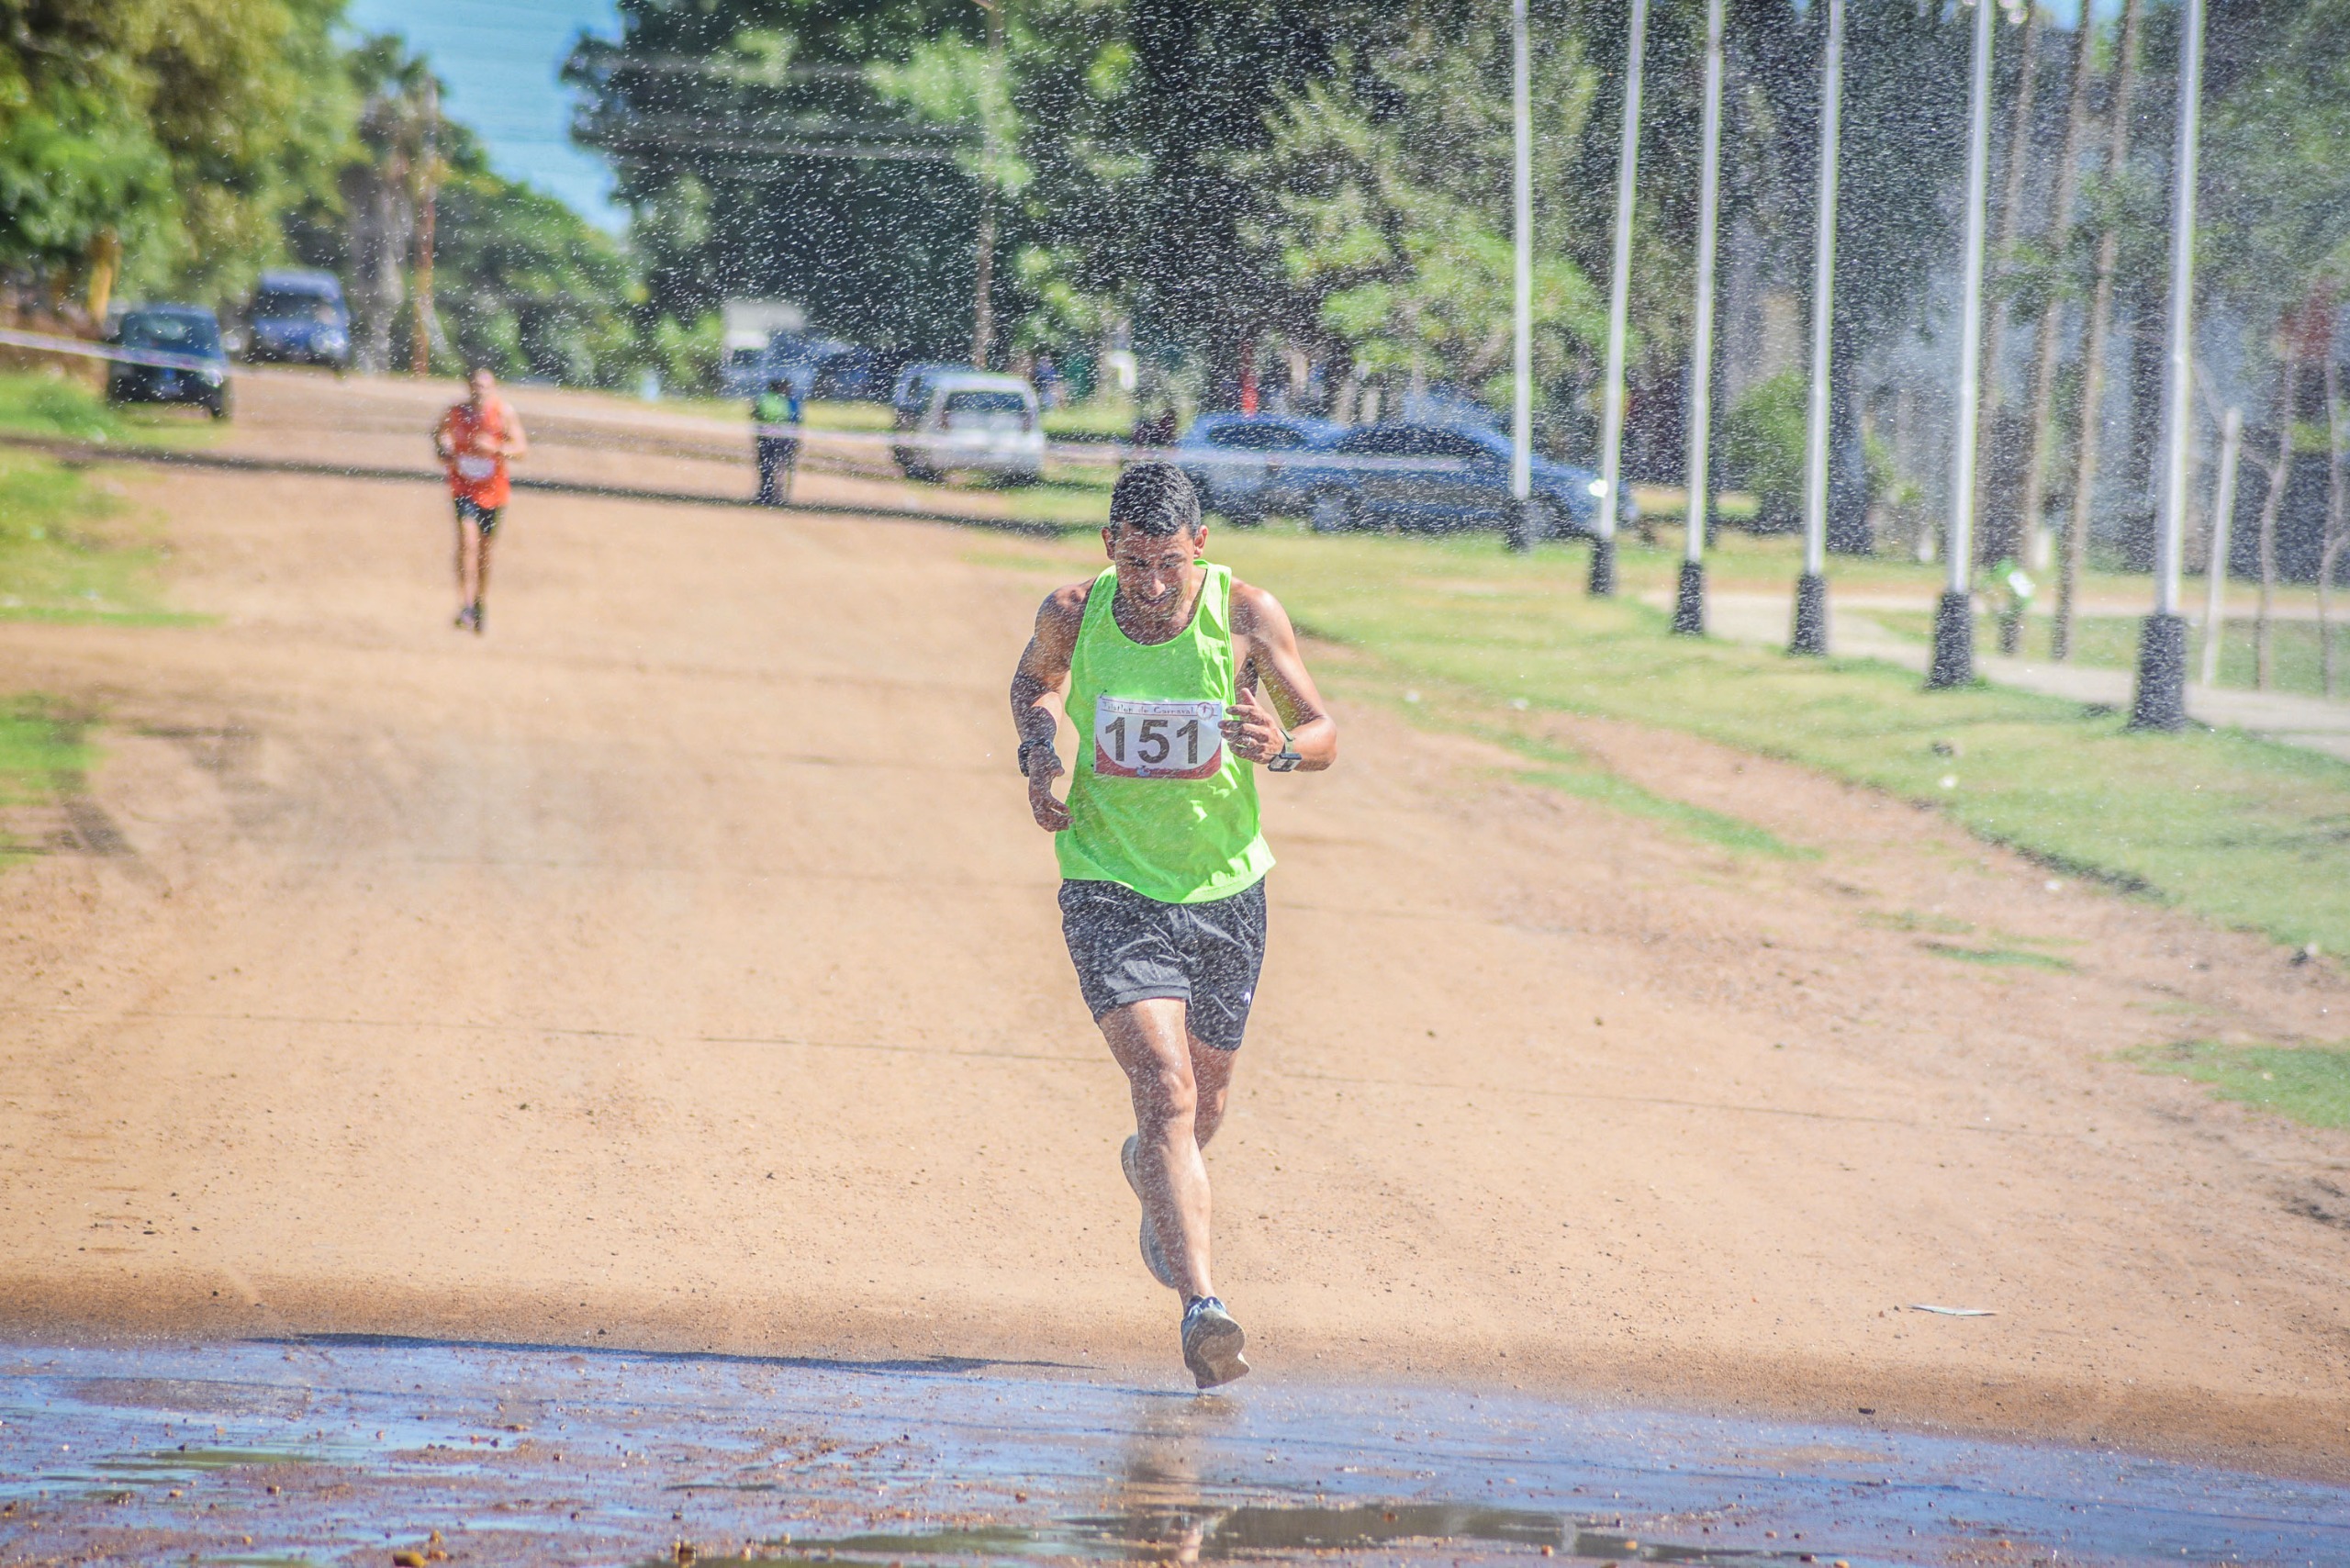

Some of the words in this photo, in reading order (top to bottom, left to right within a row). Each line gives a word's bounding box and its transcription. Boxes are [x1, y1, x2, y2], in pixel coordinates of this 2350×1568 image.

[1138, 705, 1149, 714] de
[1153, 706, 1194, 715] Carnaval
[1105, 716, 1199, 765] 151
